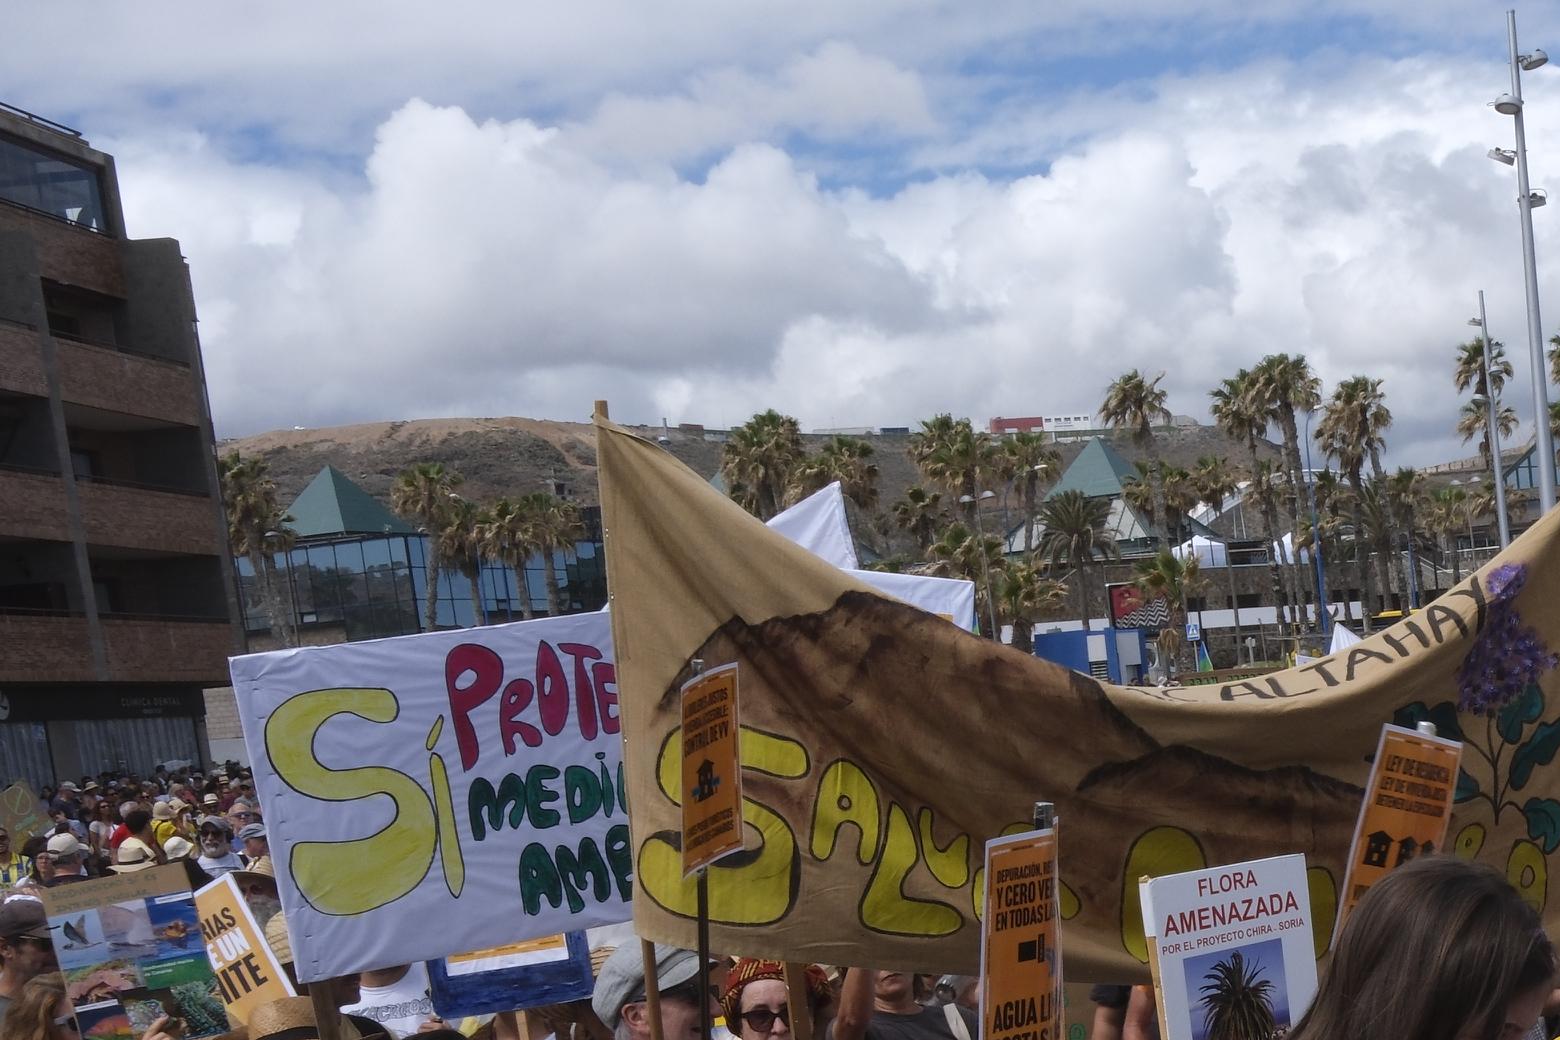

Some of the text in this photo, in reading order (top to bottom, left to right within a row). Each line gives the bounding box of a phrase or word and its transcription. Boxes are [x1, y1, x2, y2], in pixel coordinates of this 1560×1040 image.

[1220, 575, 1489, 703] ALTAHAY
[996, 887, 1004, 909] Y
[1005, 881, 1036, 908] CERO
[1196, 869, 1259, 898] FLORA
[995, 910, 1008, 932] EN
[1008, 904, 1044, 929] TODAS
[1163, 890, 1300, 939] AMENAZADA
[216, 926, 251, 963] UN
[1161, 941, 1182, 956] POR
[1183, 938, 1196, 951] EL
[1196, 929, 1245, 950] PROYECTO
[1246, 925, 1274, 938] CHIRA
[1278, 917, 1306, 932] SORIA
[992, 997, 1038, 1035] AGUA
